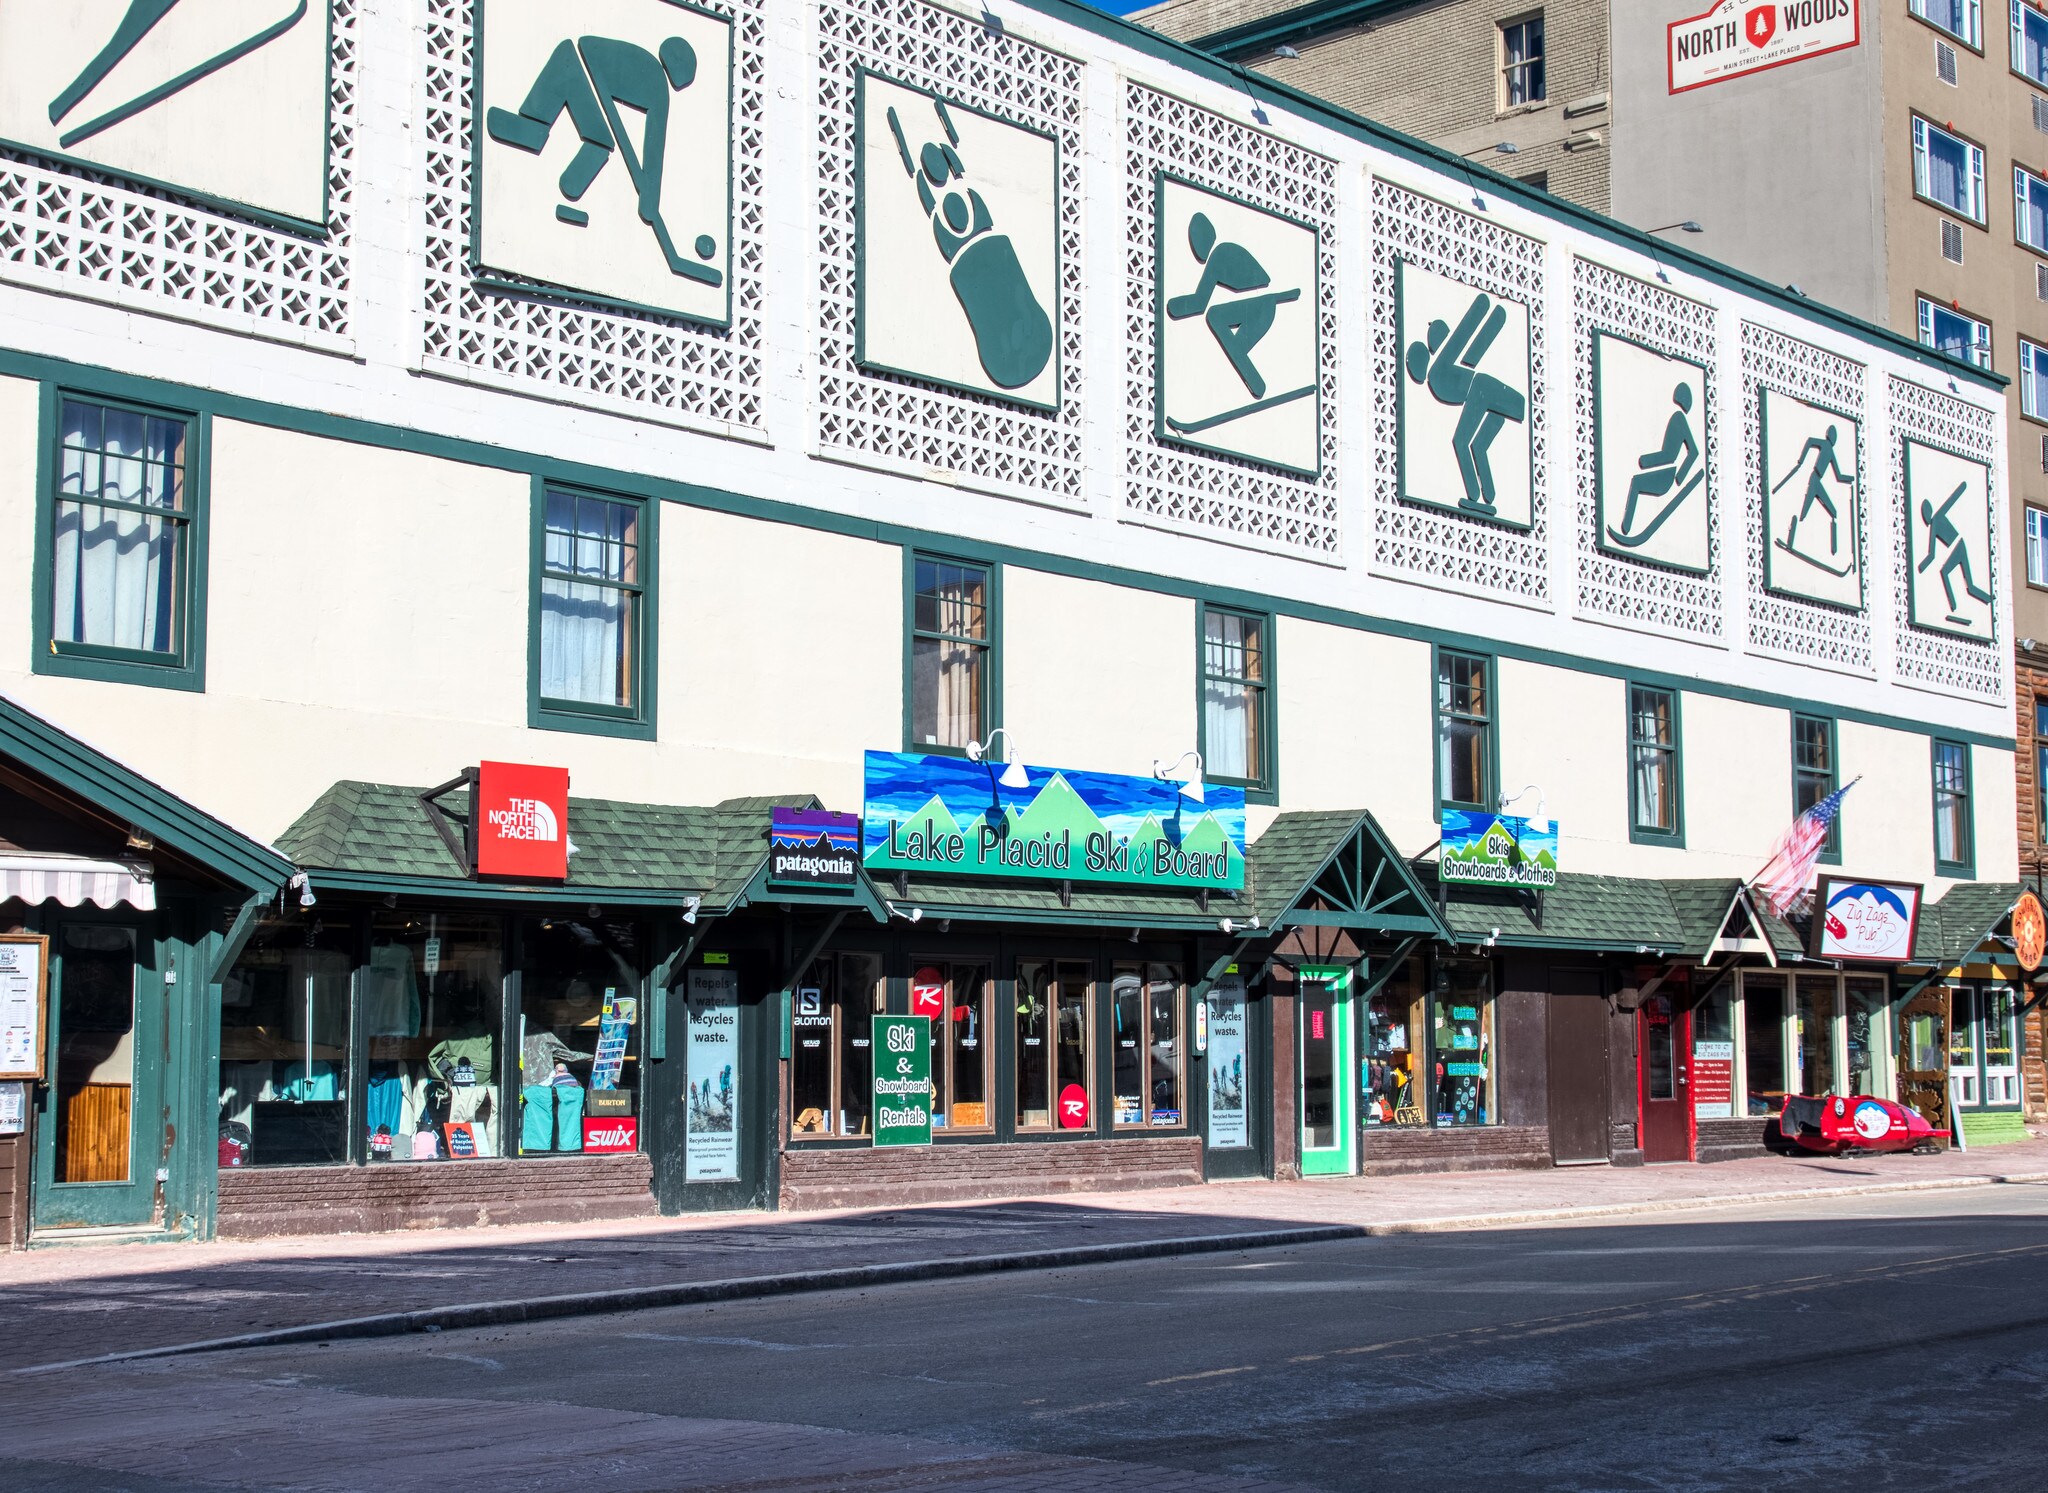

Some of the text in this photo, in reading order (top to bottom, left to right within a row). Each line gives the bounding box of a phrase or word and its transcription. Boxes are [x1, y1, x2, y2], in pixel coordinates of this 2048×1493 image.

[1677, 0, 1849, 62] NORTH WOODS
[1723, 45, 1801, 70] MAIN STREET LAKE PLACID
[509, 797, 535, 813] THE
[489, 809, 534, 827] NORTH
[501, 824, 534, 840] FACE
[888, 818, 1229, 880] Lake Placid Ski & Board
[1487, 835, 1510, 857] Skis
[775, 855, 854, 877] patagonia
[1443, 856, 1555, 884] Snowboards & Clothes
[1846, 903, 1889, 930] Zig Zags
[1857, 925, 1878, 941] Pub
[694, 976, 730, 991] Repels
[695, 995, 728, 1007] water.
[689, 1012, 734, 1028] Recycles
[793, 1016, 832, 1026] alomon
[1210, 1011, 1242, 1024] Recycles
[694, 1032, 729, 1043] waste.
[887, 1024, 916, 1052] Ski
[1214, 1026, 1239, 1036] waste.
[896, 1057, 914, 1074] &
[876, 1076, 929, 1094] Snowboard
[598, 1099, 626, 1107] BURTON
[880, 1105, 927, 1129] Rentals
[1151, 1117, 1176, 1126] patagonia
[688, 1136, 711, 1145] Recycled
